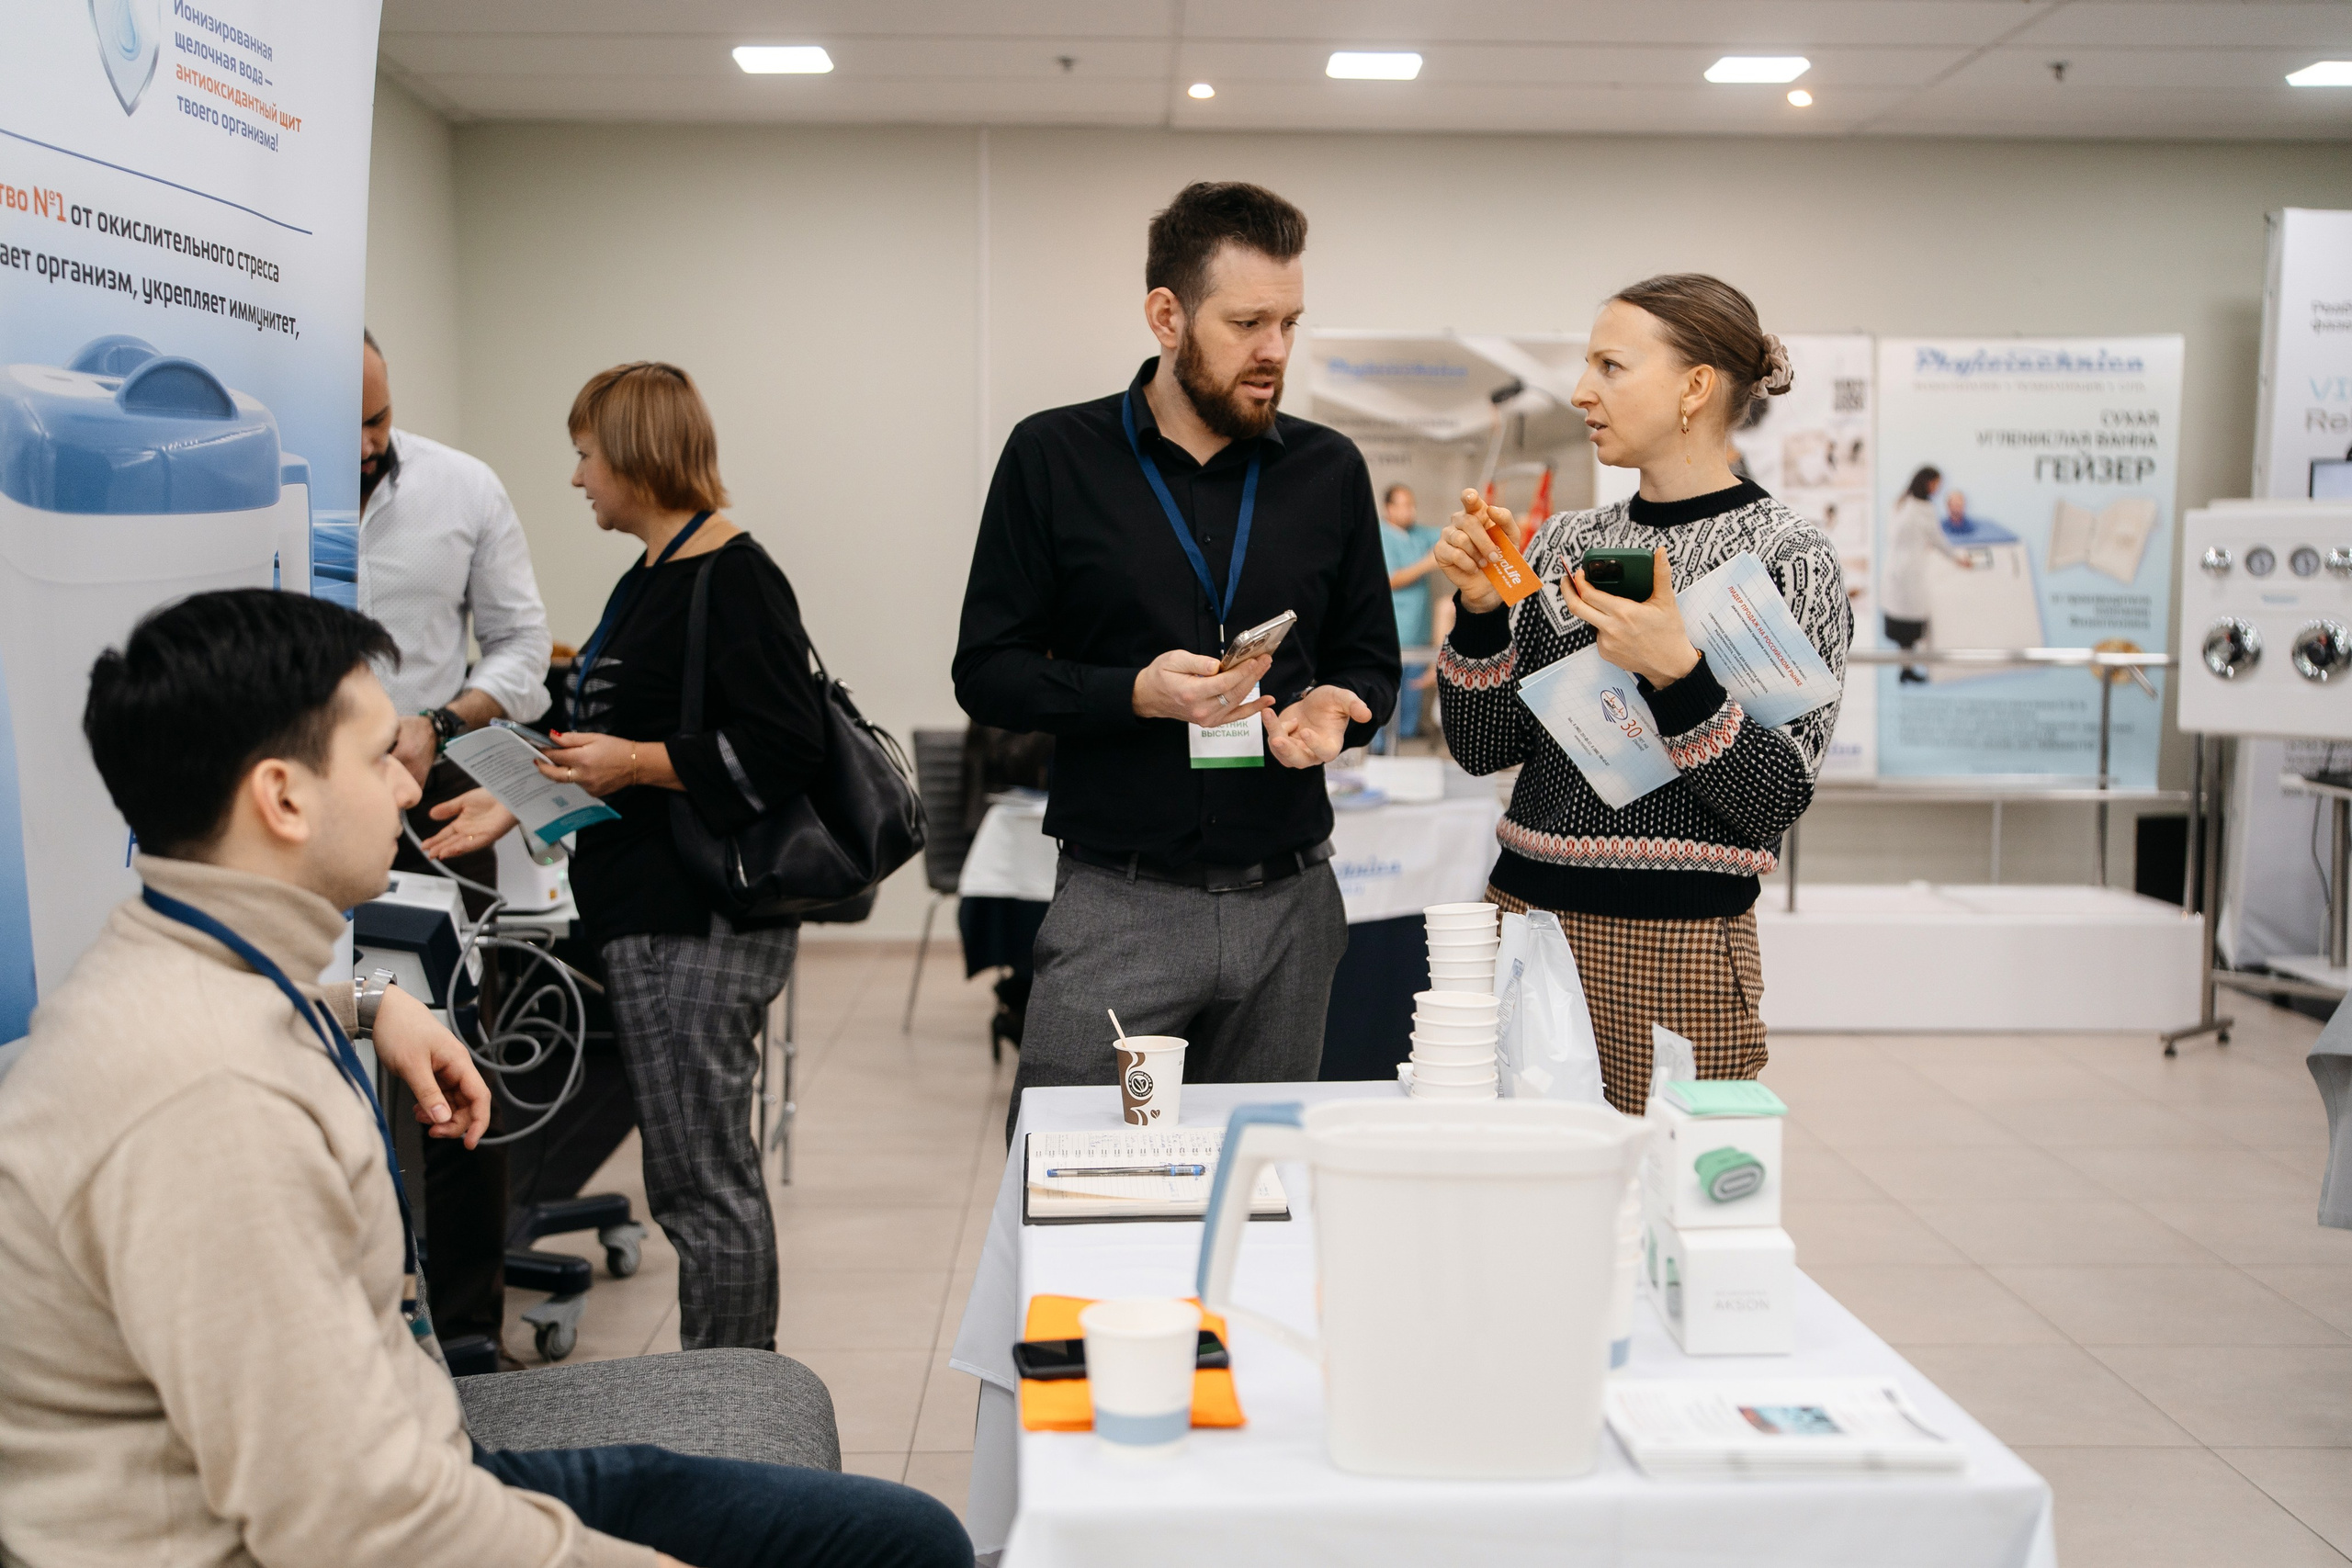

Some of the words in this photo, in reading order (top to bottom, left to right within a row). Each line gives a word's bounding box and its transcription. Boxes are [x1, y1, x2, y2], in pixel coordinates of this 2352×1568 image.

[175, 31, 237, 73] щелочная
[240, 61, 264, 86] вода
[175, 63, 277, 122] антиоксидантный
[279, 113, 301, 132] щит
[176, 95, 219, 126] твоего
[221, 116, 278, 152] организма!
[71, 204, 93, 229] от
[97, 211, 234, 266] окислительного
[237, 252, 279, 282] стресса
[37, 253, 137, 299] организм,
[142, 277, 226, 314] укрепляет
[229, 302, 300, 340] иммунитет,
[2309, 377, 2352, 400] VI
[2306, 408, 2352, 433] Re
[2034, 449, 2156, 483] ГЕЙЗЕР
[1727, 585, 1743, 604] ЛИДЕР
[1740, 604, 1759, 627] ПРОДАЖ
[1763, 635, 1791, 669] РОССИЙСКОМ
[1788, 669, 1802, 686] РЫНКЕ
[1201, 729, 1250, 739] ВЫСТАВКИ
[1620, 718, 1643, 738] 30
